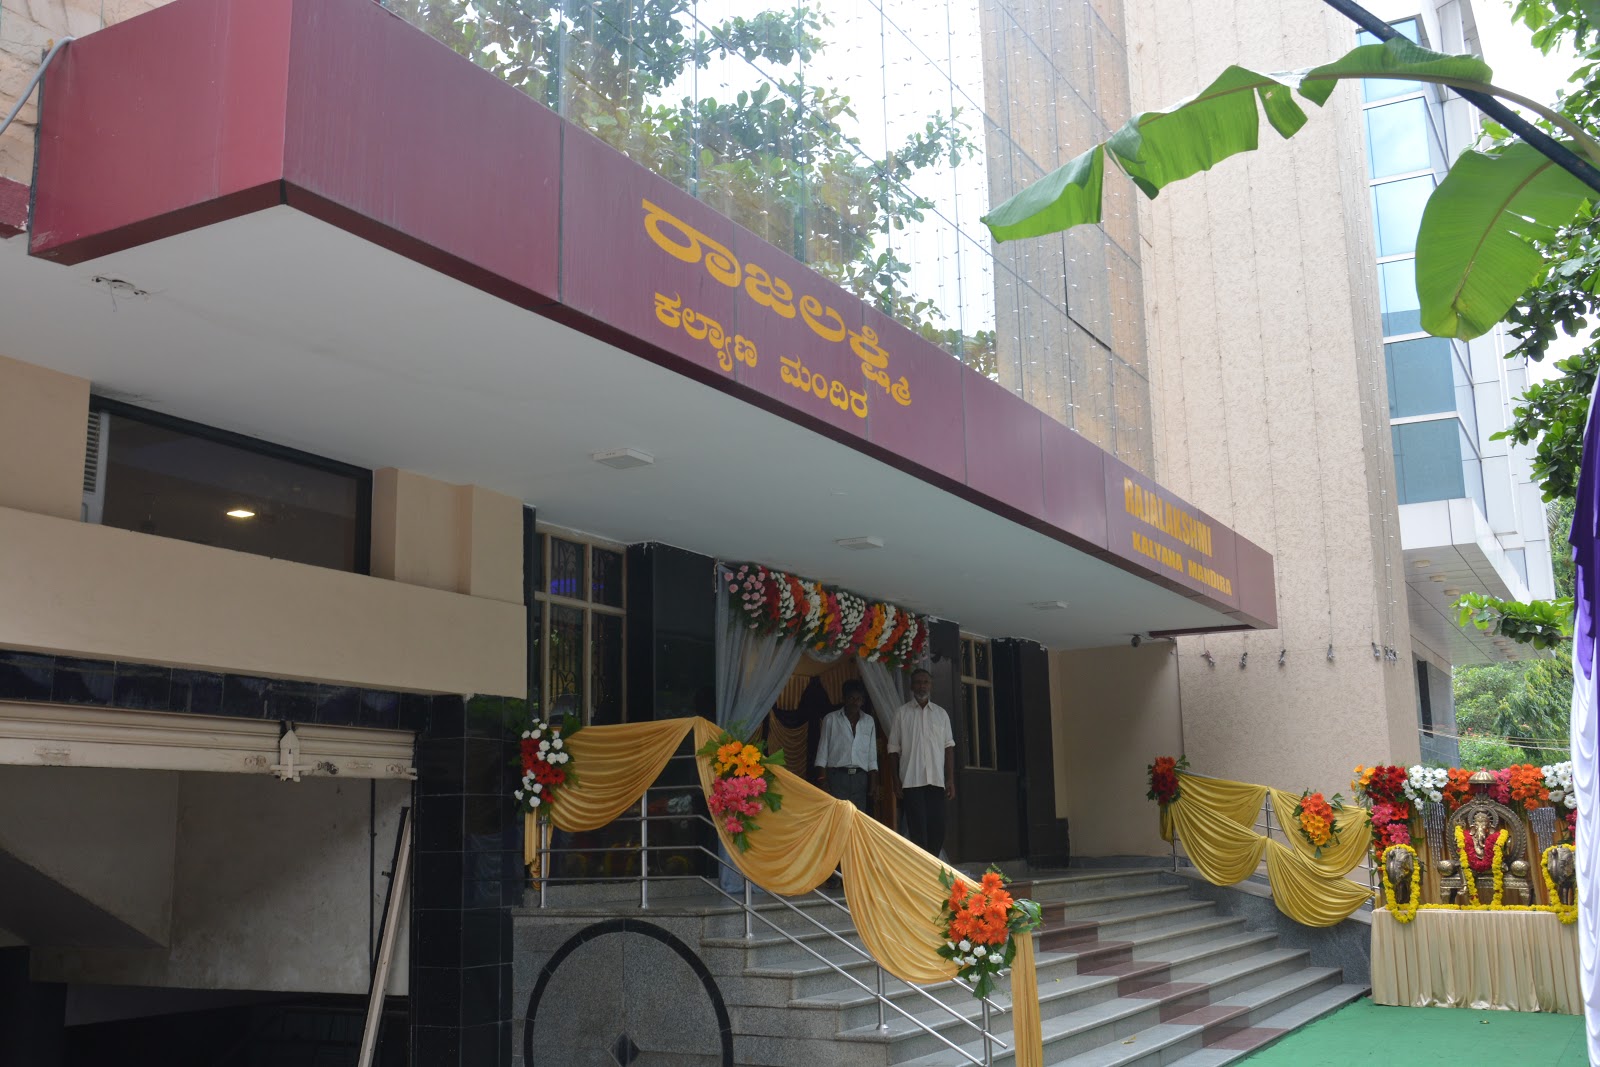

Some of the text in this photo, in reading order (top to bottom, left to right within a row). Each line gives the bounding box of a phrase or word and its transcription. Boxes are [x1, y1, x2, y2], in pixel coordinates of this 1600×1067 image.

[654, 291, 868, 418] ಕಲ್ಯಾಣ ಮಂದಿರ
[1123, 476, 1212, 558] RAJALAKSHMI
[1132, 530, 1232, 596] KALYANA MANDIRA
